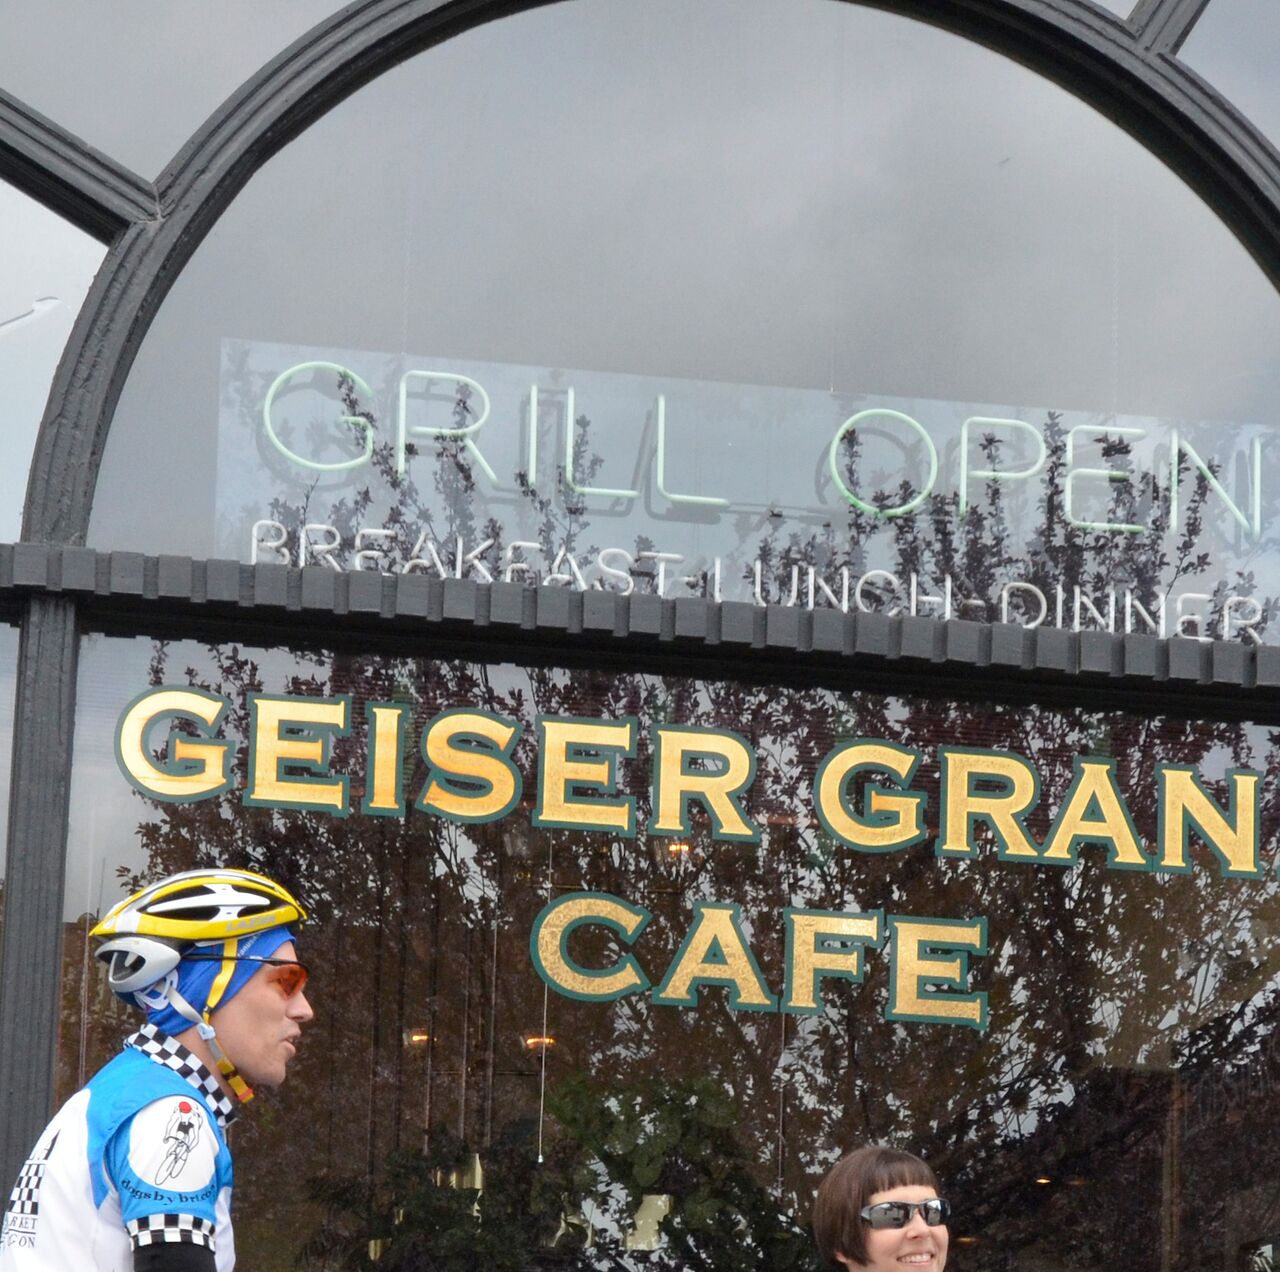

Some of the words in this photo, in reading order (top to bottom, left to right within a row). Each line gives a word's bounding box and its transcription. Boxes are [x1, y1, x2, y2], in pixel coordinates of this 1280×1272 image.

[262, 360, 730, 507] GRILL
[828, 407, 1262, 542] OPEN
[118, 688, 758, 842] GEISER
[531, 891, 990, 1029] CAFE
